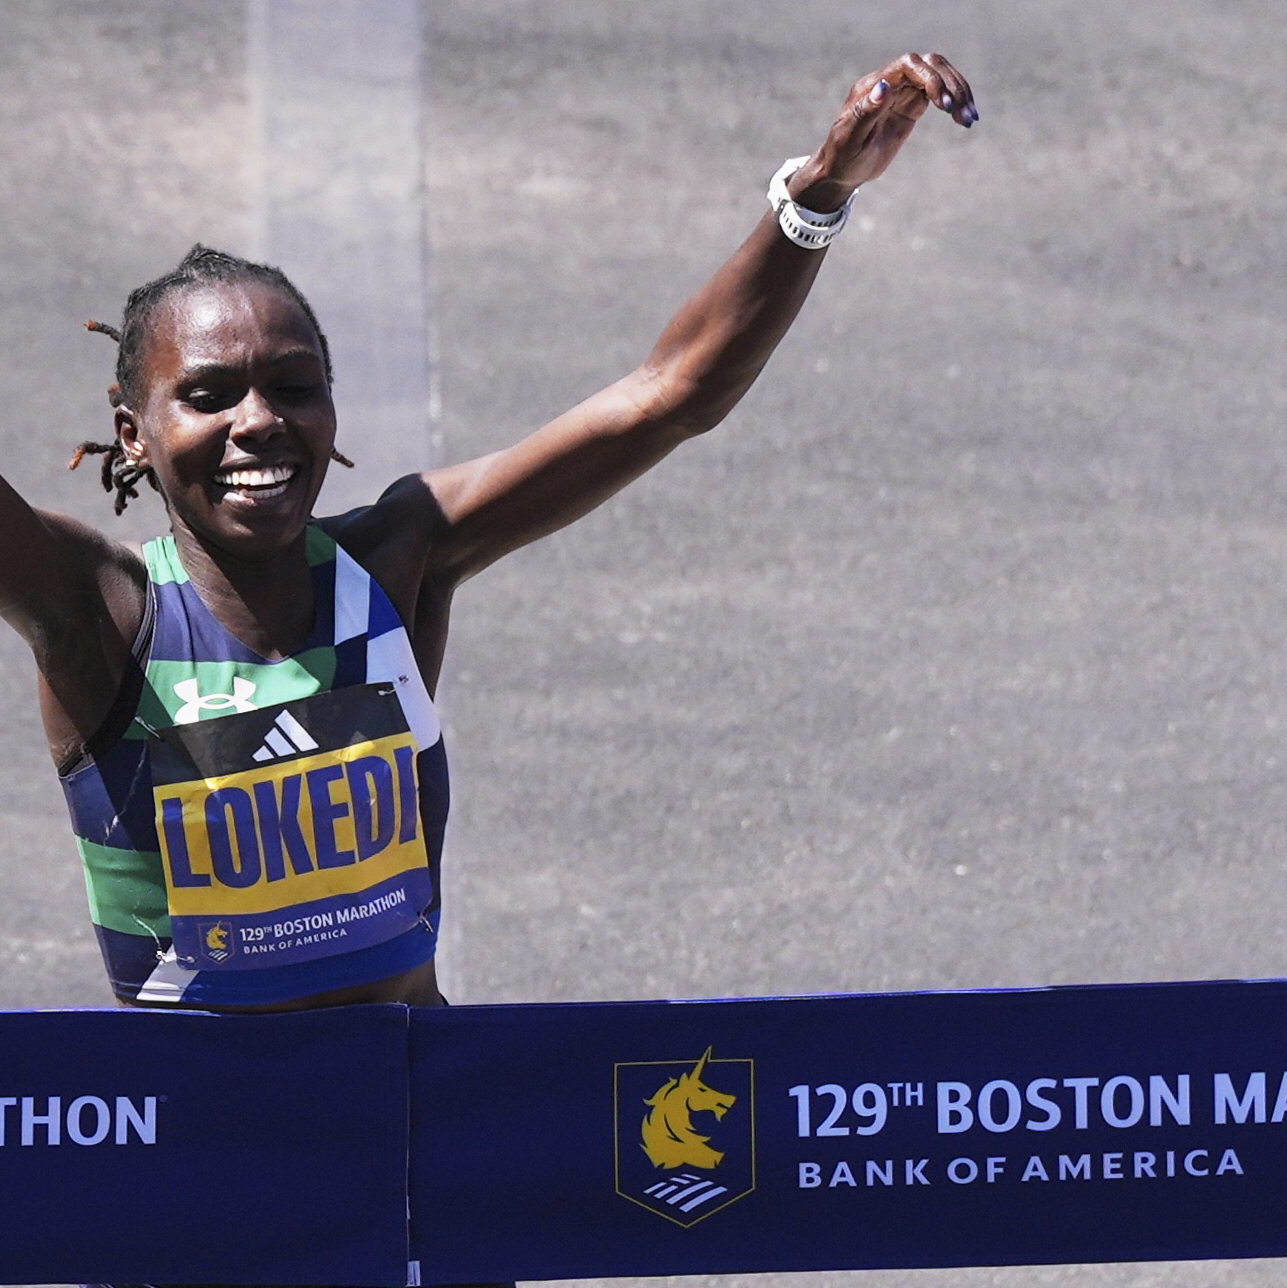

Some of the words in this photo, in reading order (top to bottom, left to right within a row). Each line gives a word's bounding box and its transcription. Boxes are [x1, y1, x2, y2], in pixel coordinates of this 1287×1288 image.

[161, 745, 418, 889] LOKEDI
[239, 926, 273, 942] 129TH
[274, 912, 333, 938] BOSTON
[335, 888, 407, 924] MARATHON
[244, 944, 276, 955] BANK
[278, 938, 293, 950] OF
[295, 928, 348, 947] AMERICA
[788, 1081, 925, 1137] 129TH
[936, 1073, 1192, 1134] BOSTON
[798, 1158, 931, 1188] BANK
[946, 1155, 1007, 1184] OF
[1021, 1148, 1245, 1182] AMERICA
